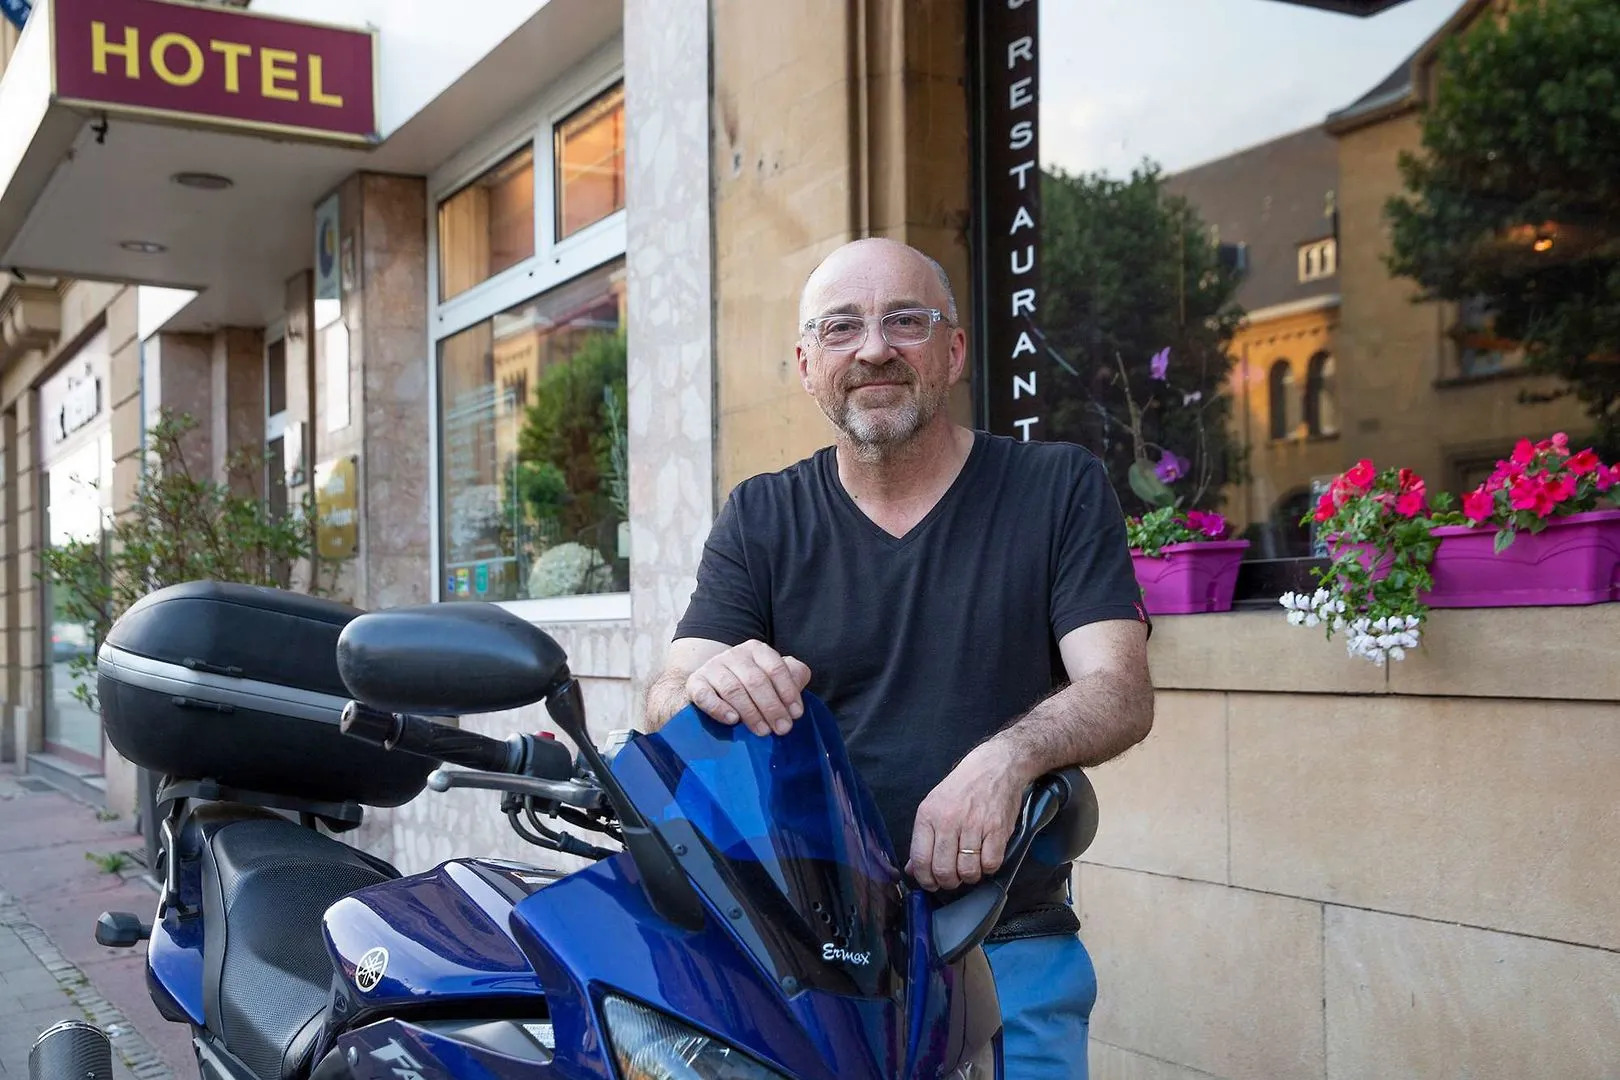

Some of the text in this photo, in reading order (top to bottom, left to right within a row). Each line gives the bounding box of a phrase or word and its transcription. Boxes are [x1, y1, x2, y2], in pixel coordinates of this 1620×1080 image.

[91, 20, 343, 107] HOTEL
[1007, 35, 1040, 442] RESTAURANT
[822, 942, 870, 965] Ermax
